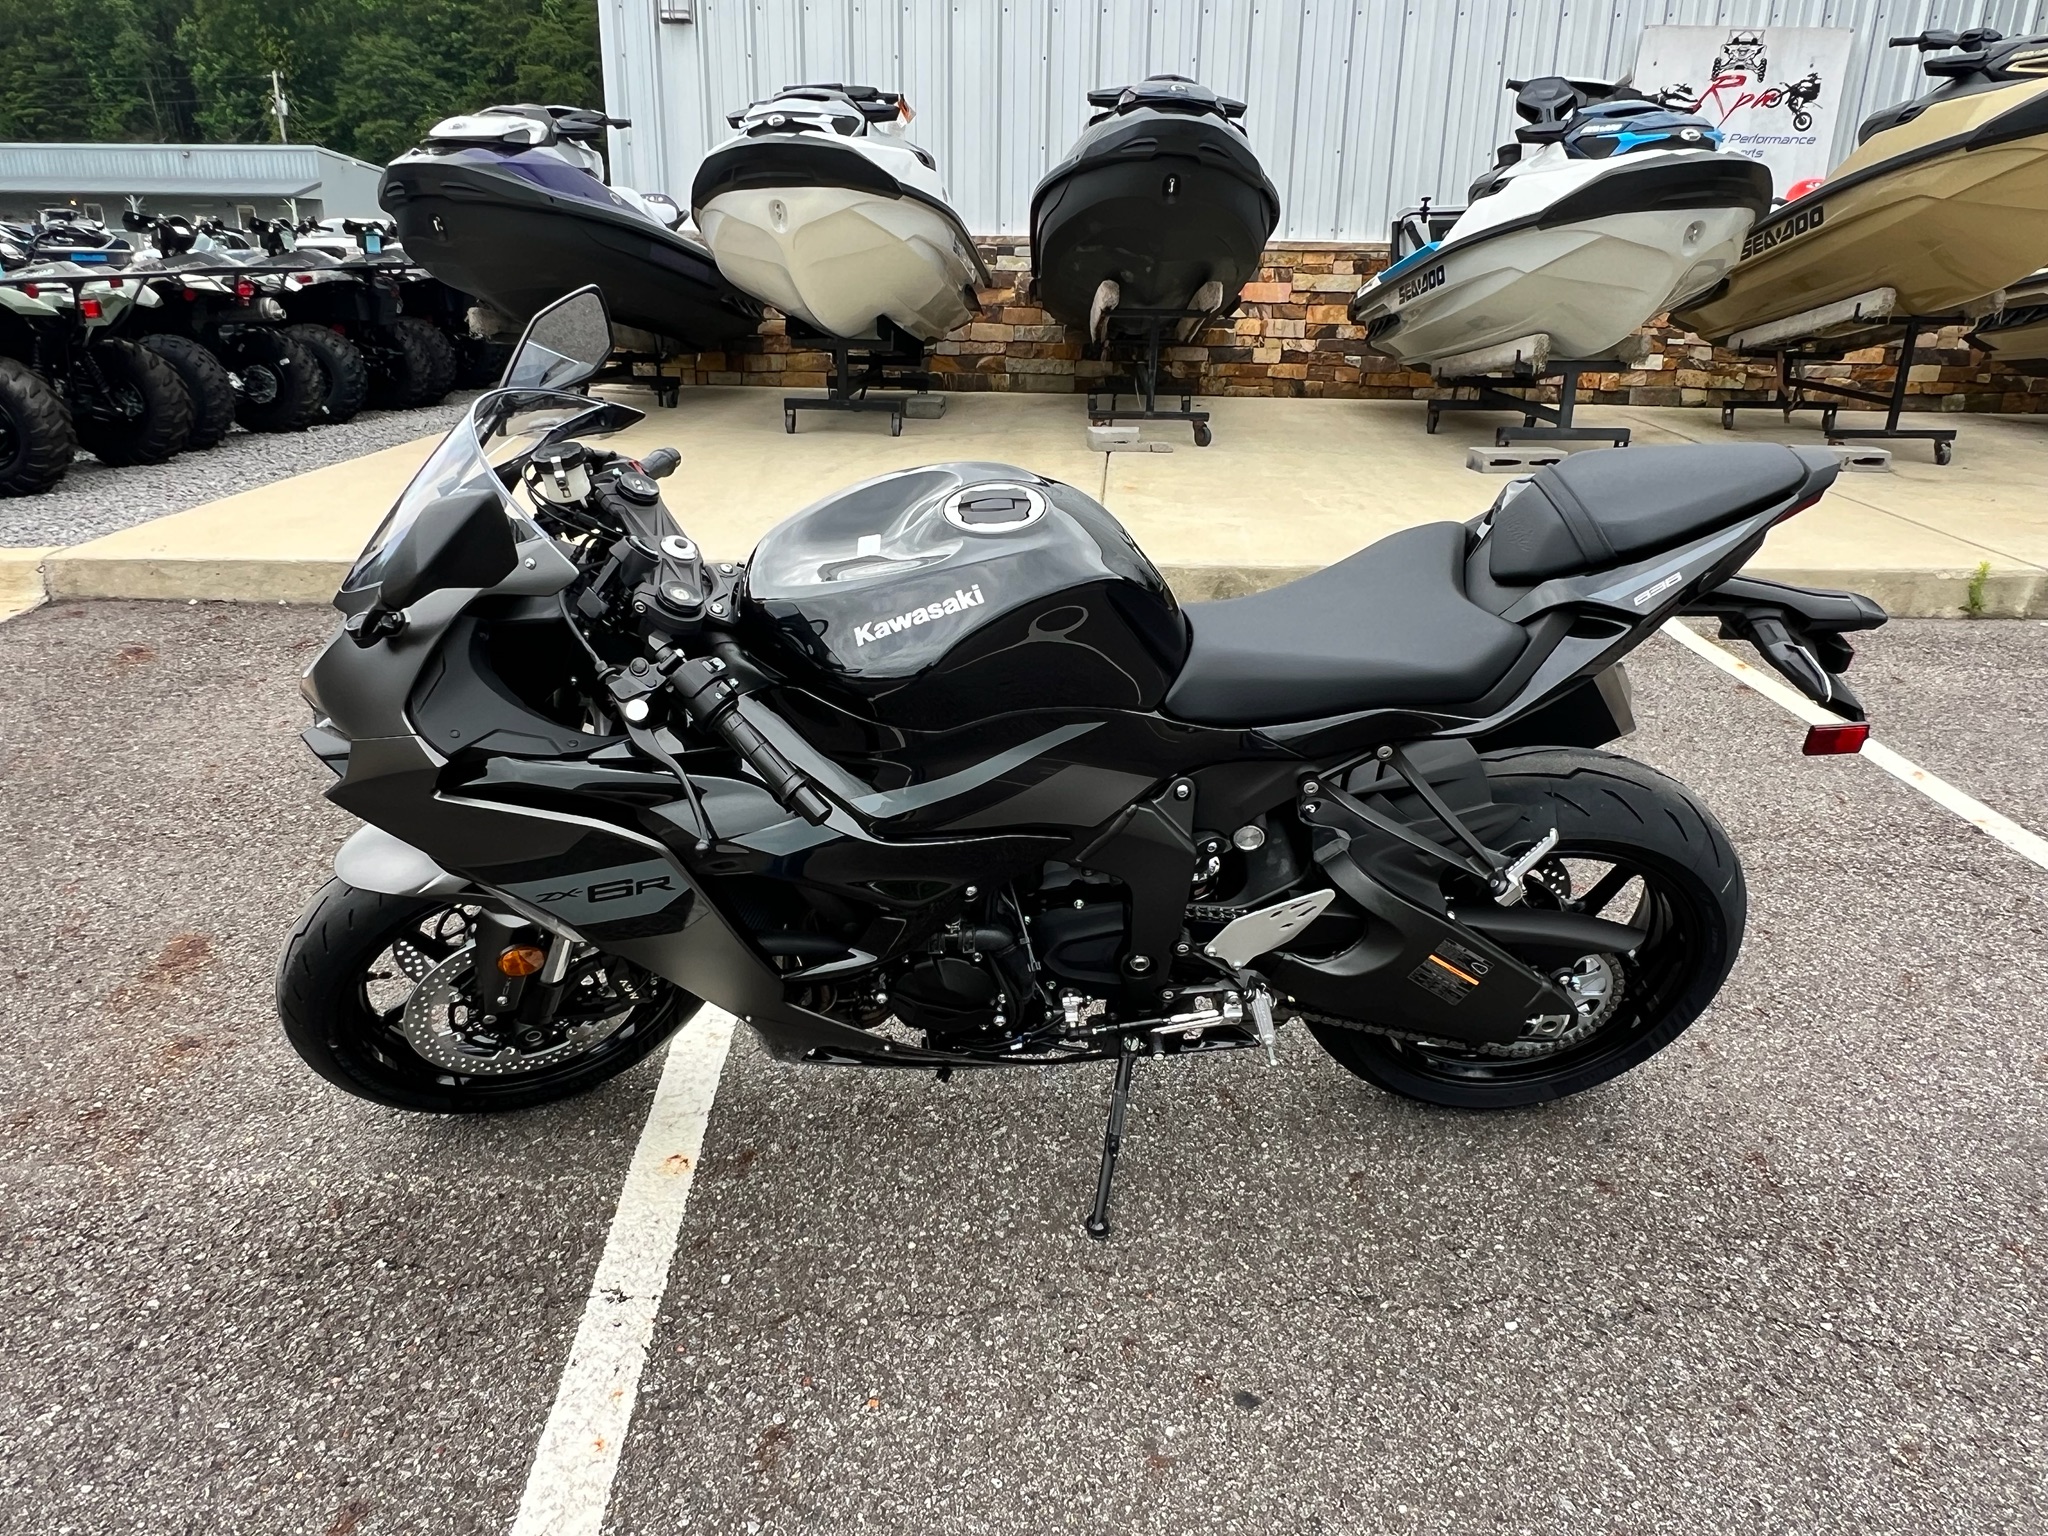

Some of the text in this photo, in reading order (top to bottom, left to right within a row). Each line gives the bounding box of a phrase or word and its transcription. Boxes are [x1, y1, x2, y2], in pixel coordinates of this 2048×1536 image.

[1728, 133, 1817, 145] Performance
[853, 583, 985, 647] Kawasaki
[535, 875, 676, 904] ZX-6R
